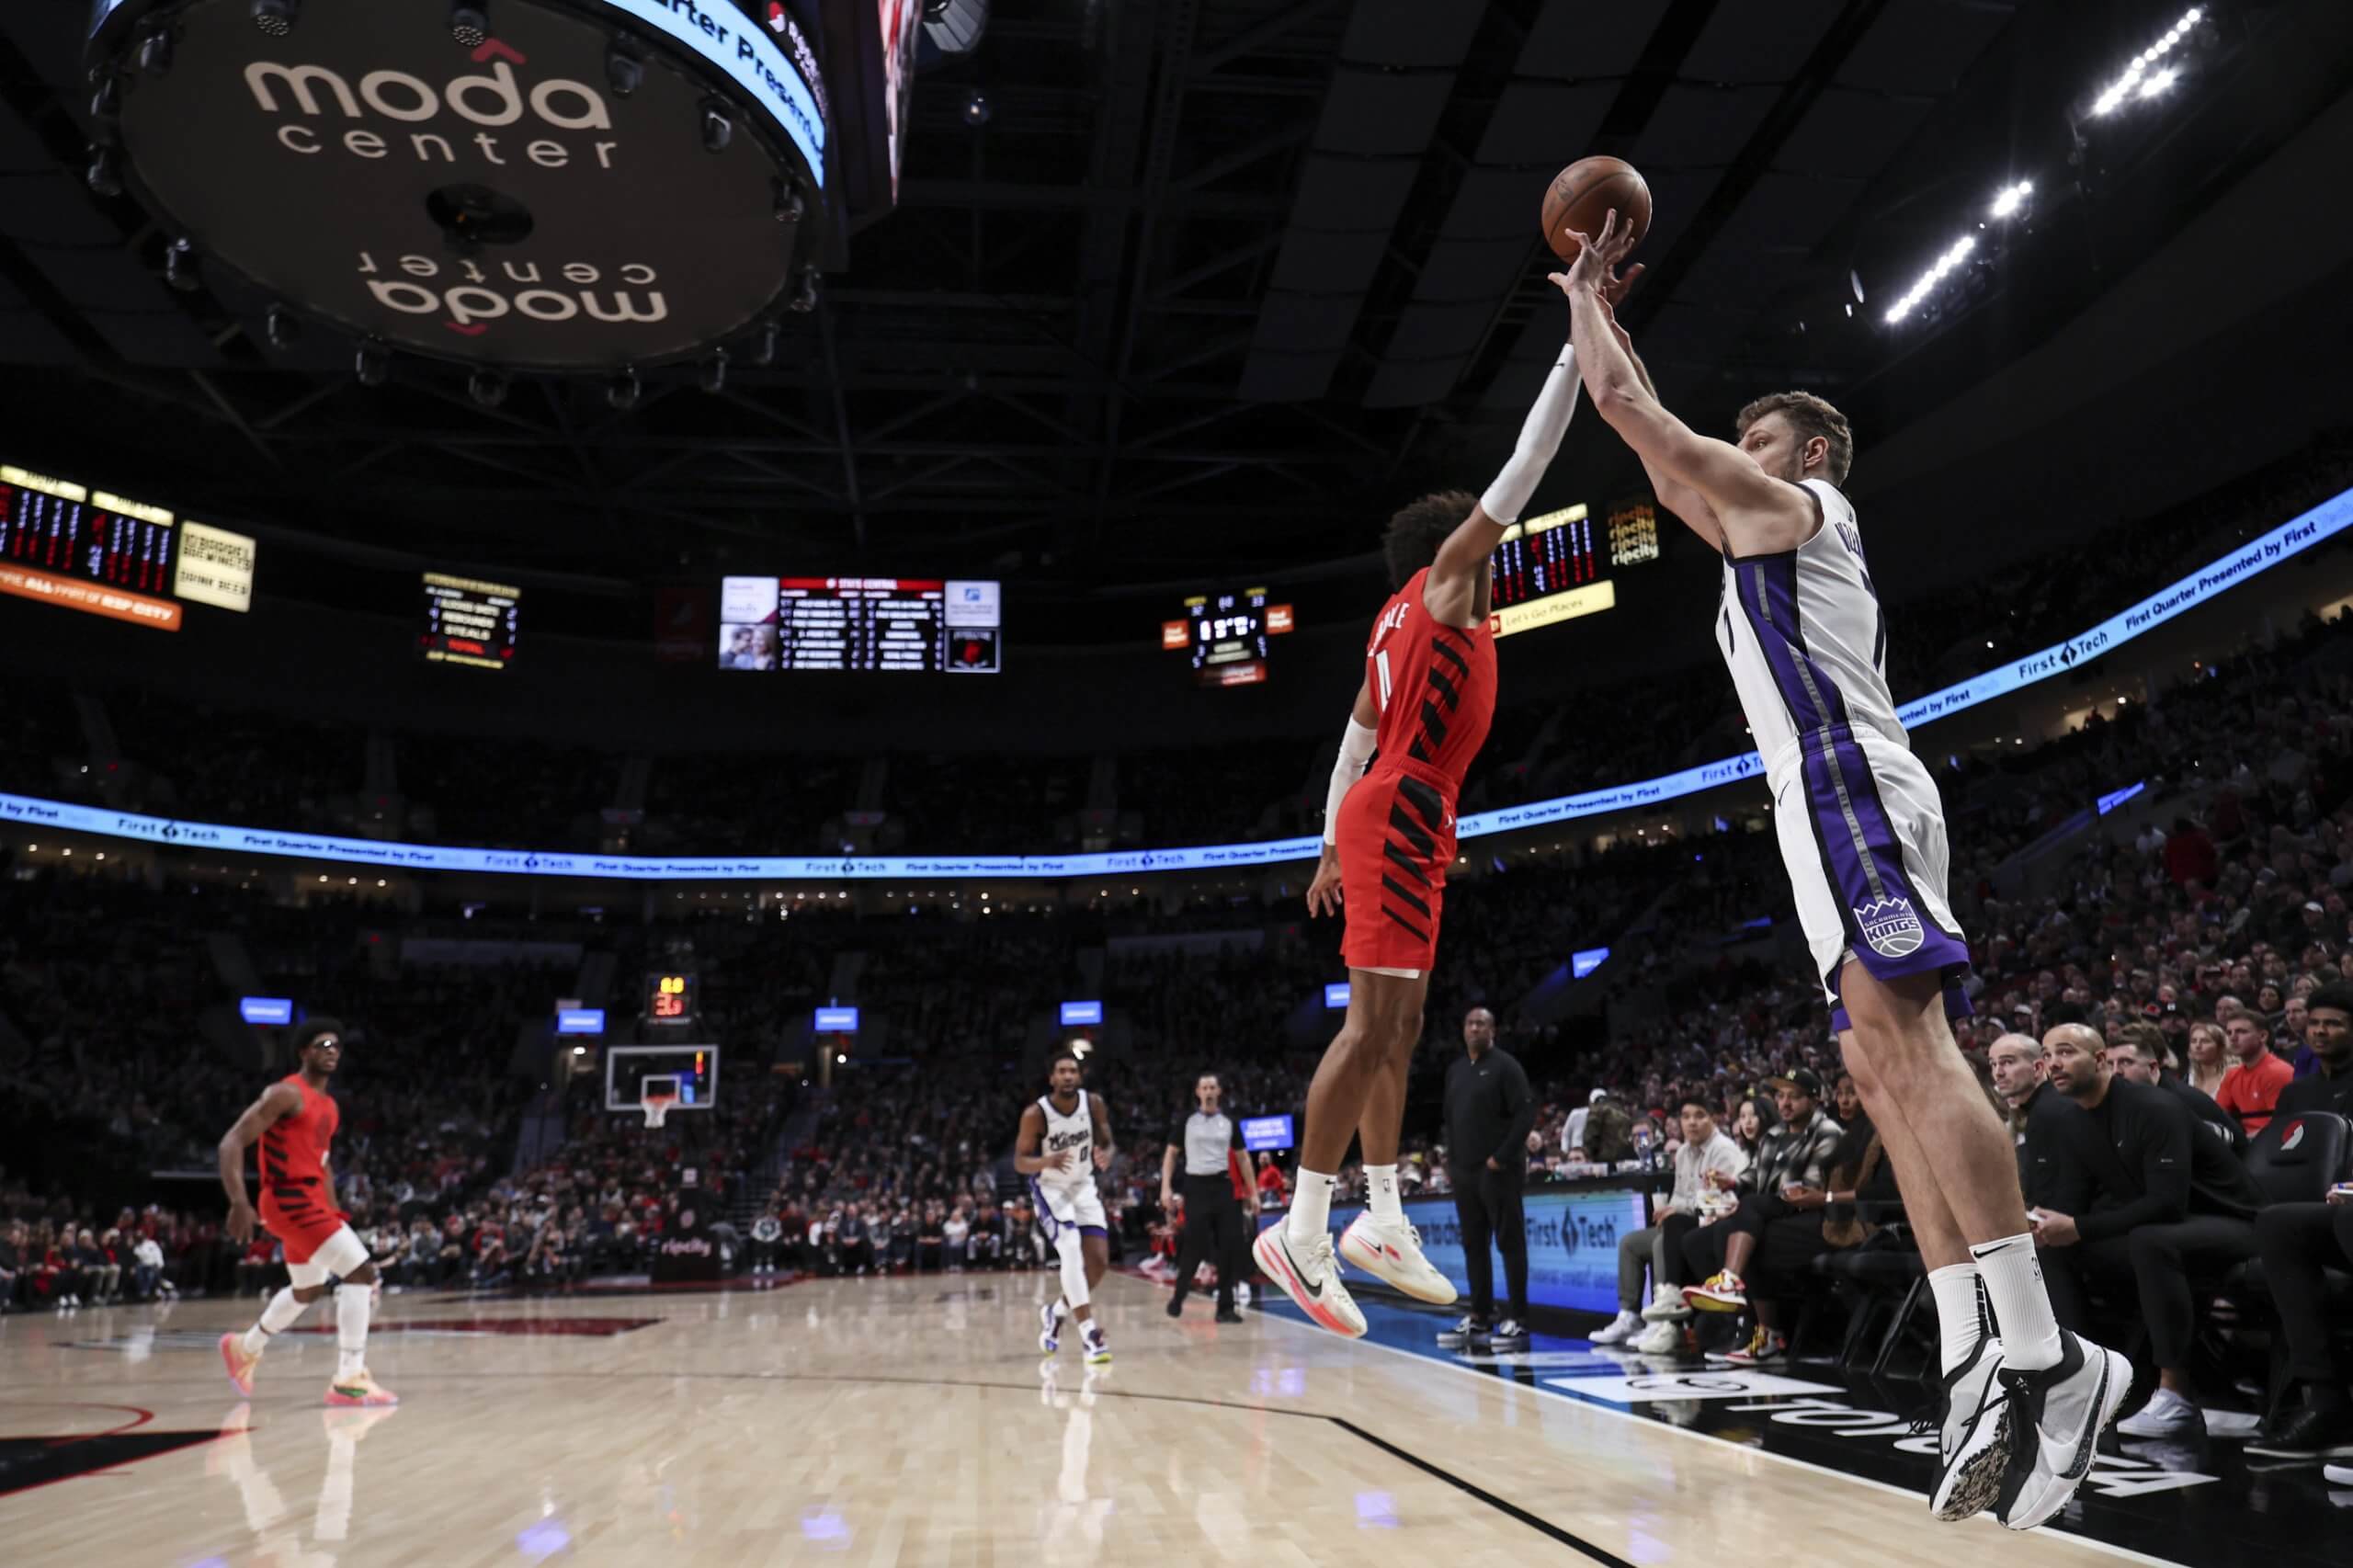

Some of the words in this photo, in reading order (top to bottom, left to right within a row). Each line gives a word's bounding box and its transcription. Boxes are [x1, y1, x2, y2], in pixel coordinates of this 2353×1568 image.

[244, 61, 611, 129] moda
[278, 125, 617, 168] center
[358, 252, 657, 285] center
[366, 278, 669, 324] moda
[2125, 609, 2151, 631] First
[2153, 586, 2196, 616] Quarter
[2199, 549, 2262, 592] Presented
[2264, 541, 2281, 556] by
[2283, 521, 2316, 548] First
[2018, 653, 2056, 678] First
[2078, 631, 2109, 656] Tech
[1930, 701, 1943, 715] by
[1946, 689, 1971, 707] First
[1701, 766, 1733, 782] First
[118, 818, 156, 834] First
[182, 828, 221, 841] Tech
[1498, 814, 1521, 825] First
[1866, 919, 1920, 942] KINGS
[1526, 1216, 1559, 1247] First
[1577, 1215, 1617, 1248] Tech
